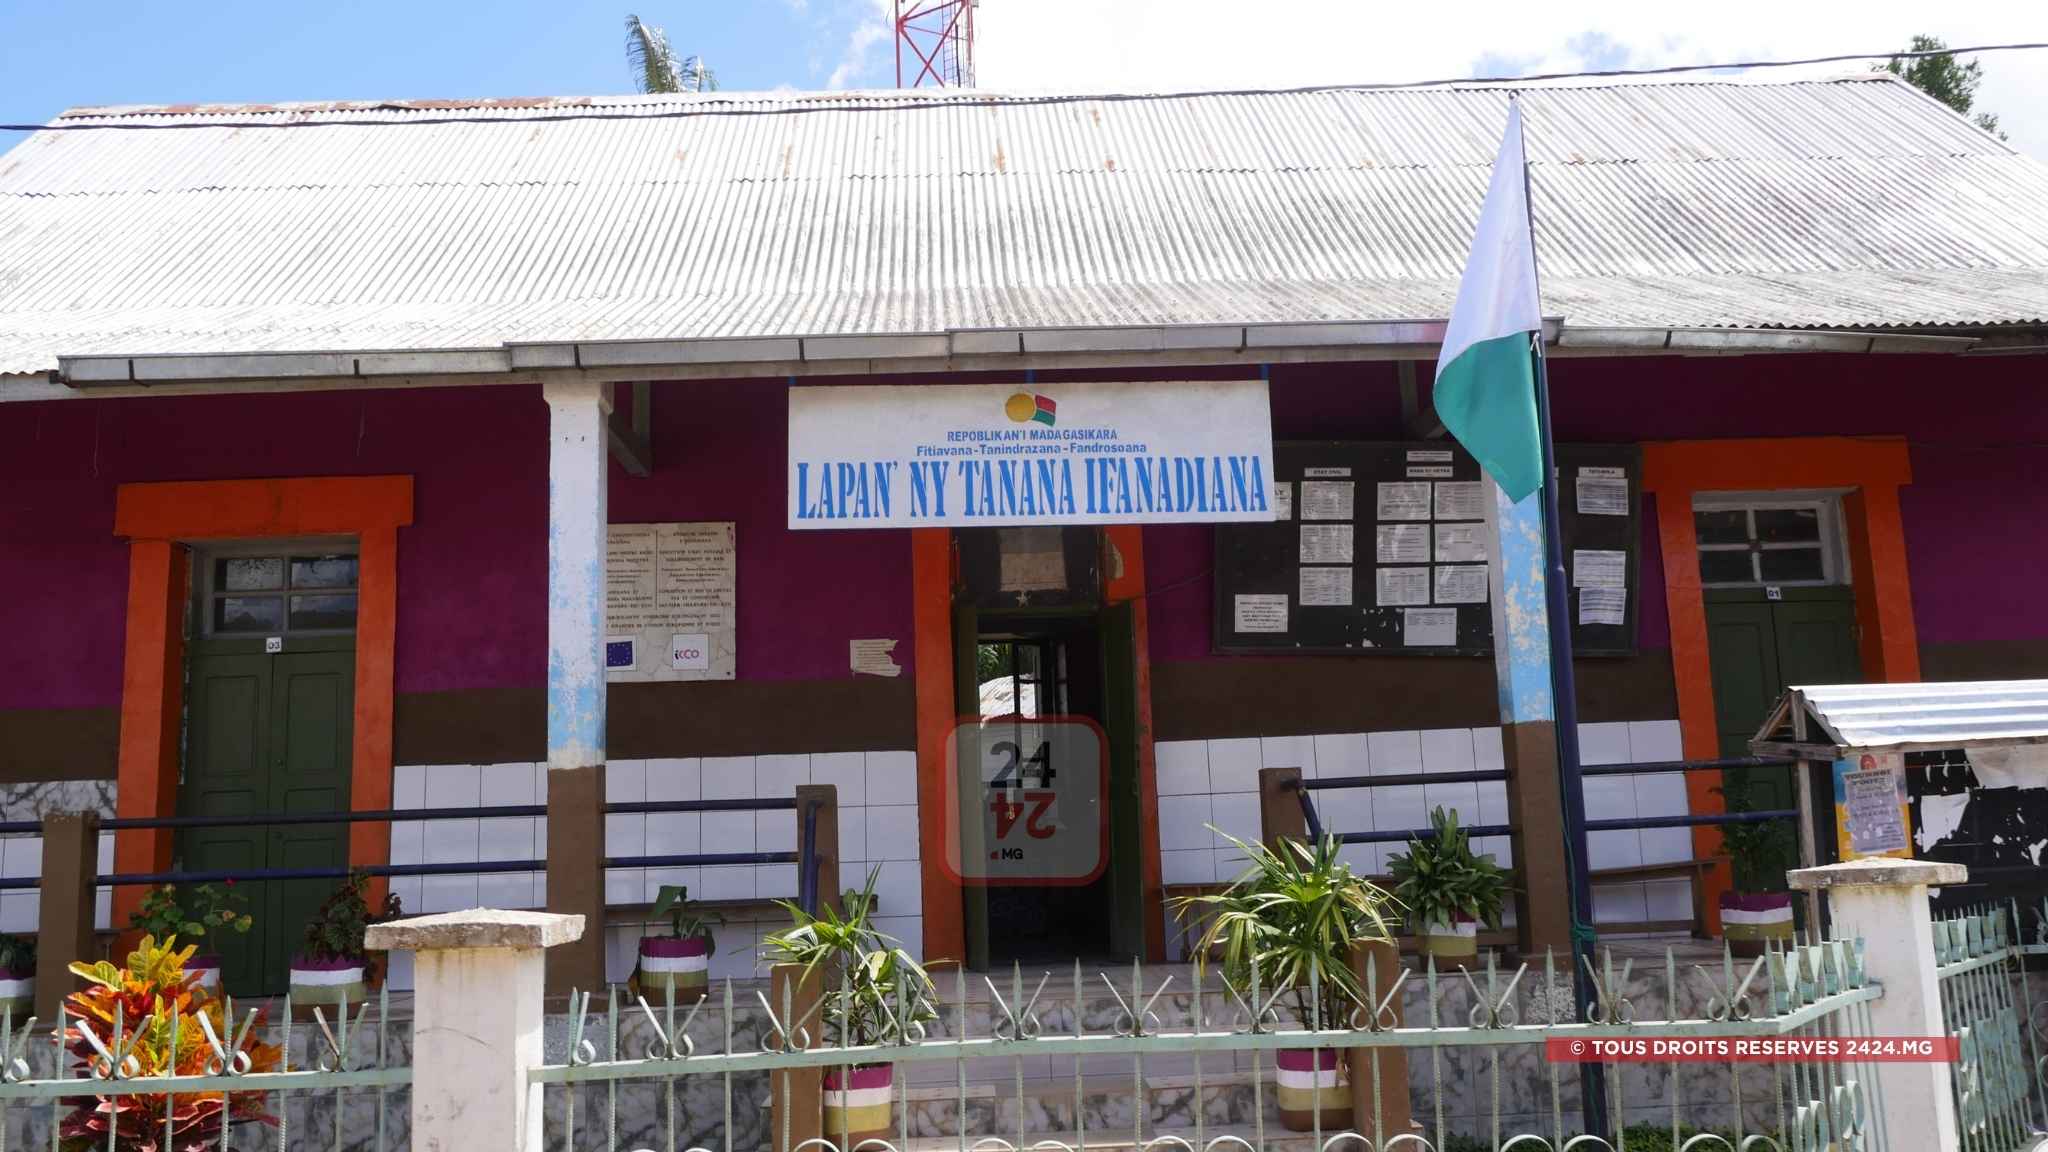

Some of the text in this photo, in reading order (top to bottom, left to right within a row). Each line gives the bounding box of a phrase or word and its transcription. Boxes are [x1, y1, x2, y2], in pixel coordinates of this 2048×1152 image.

[946, 429, 1118, 443] REPOBLIKAN'I MADAGASIKARA
[796, 461, 898, 519] LAPAN'
[909, 460, 950, 518] NY
[958, 458, 1076, 517] TANANA
[1084, 455, 1268, 514] IFANADIANA
